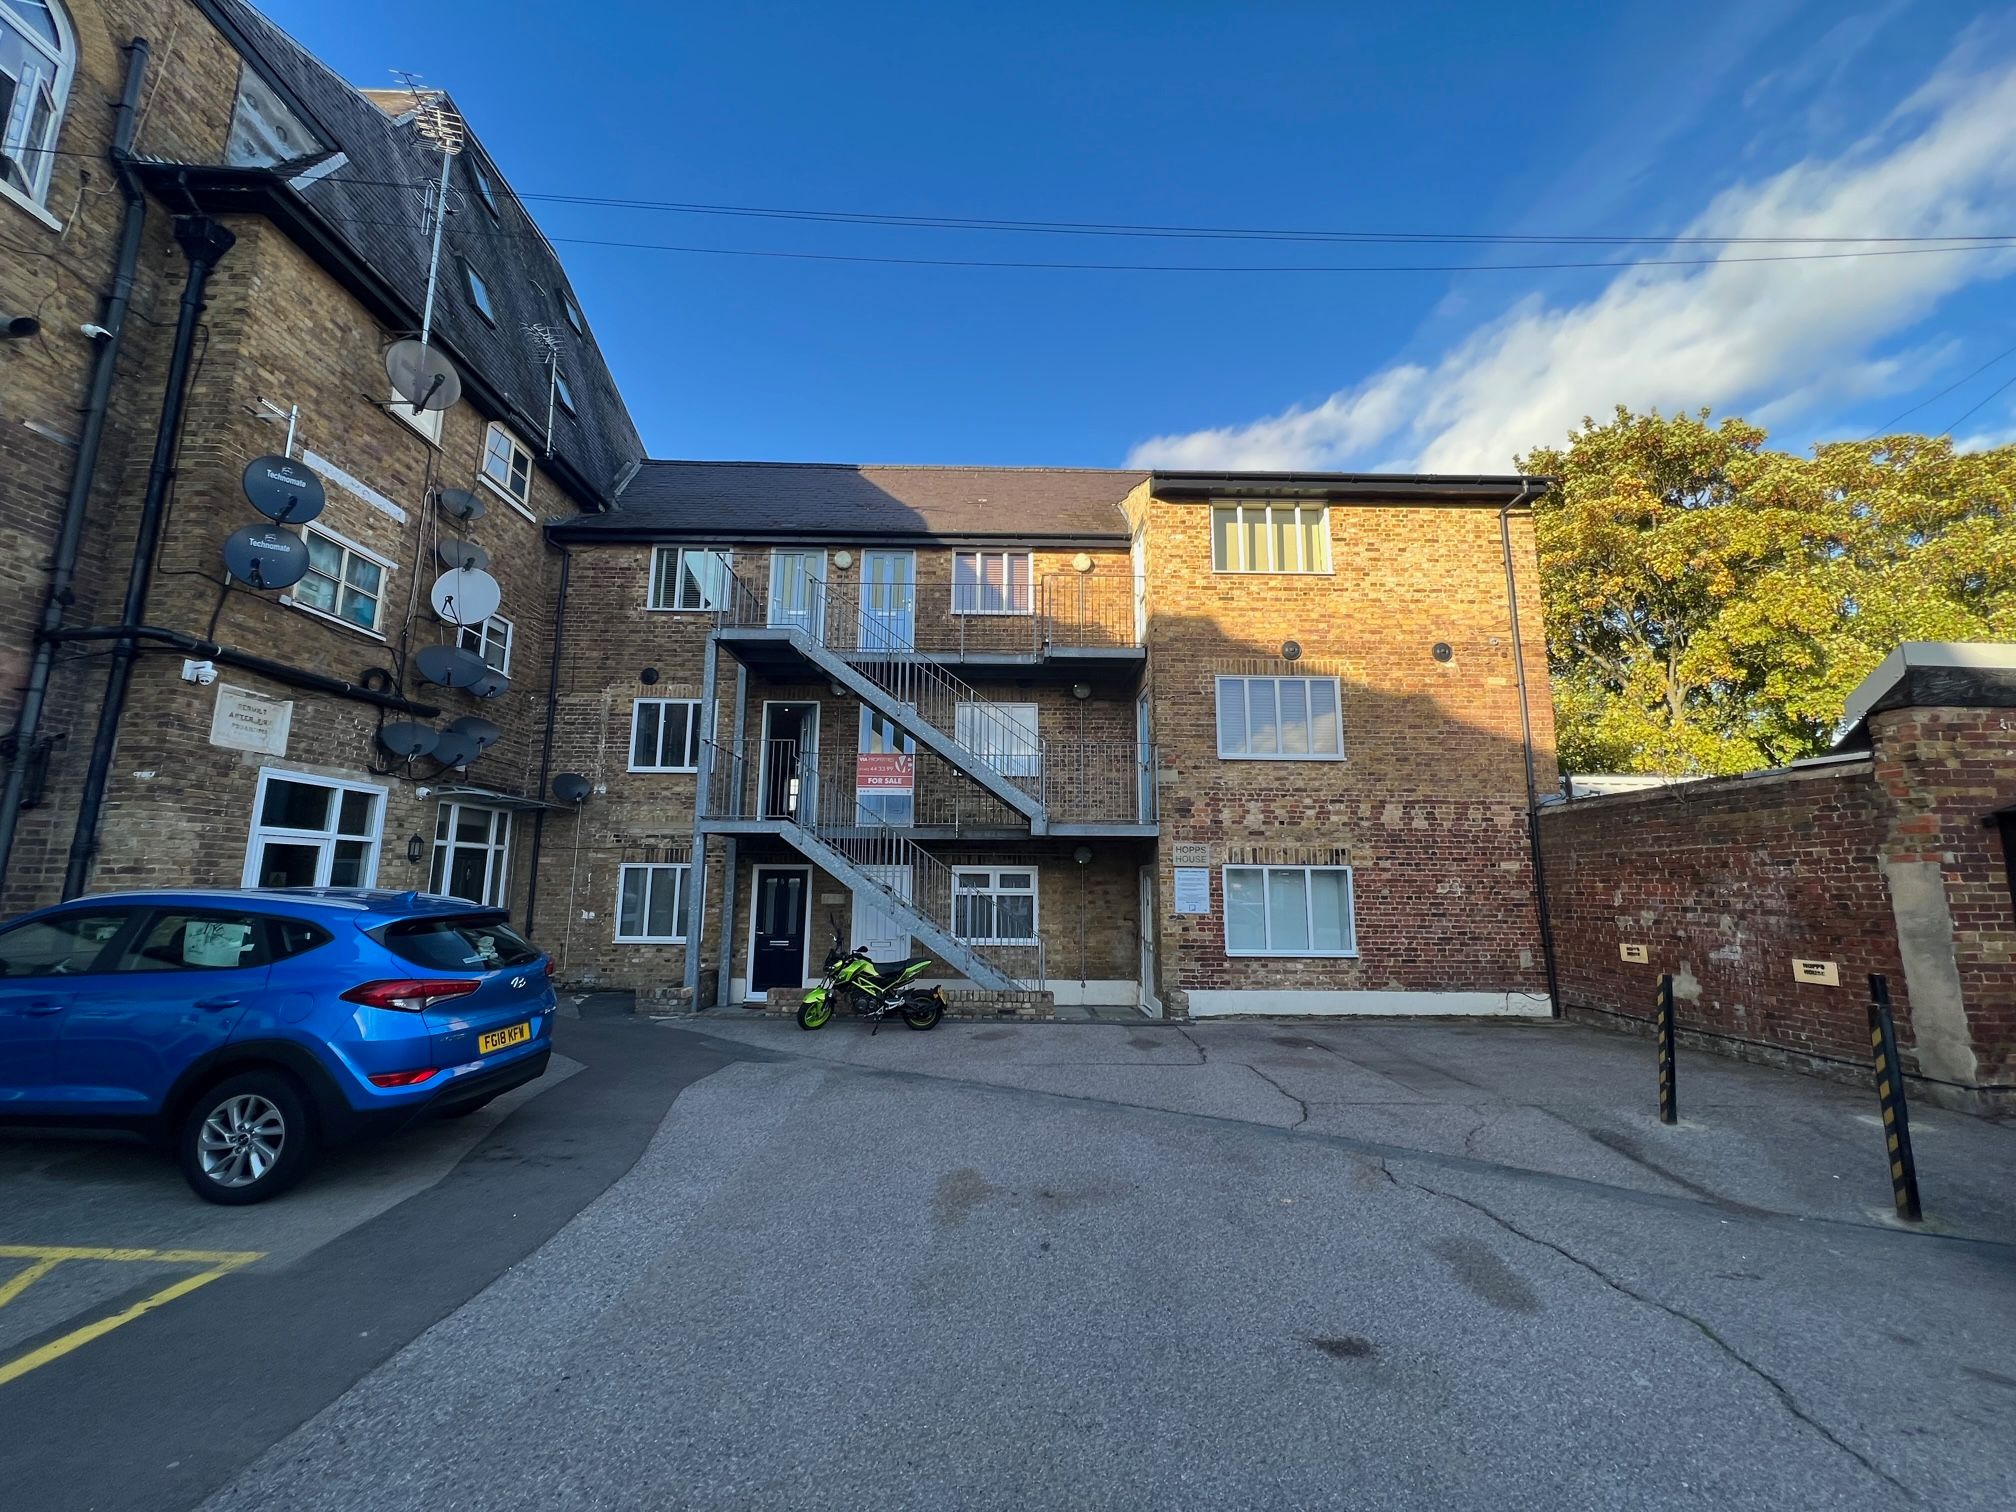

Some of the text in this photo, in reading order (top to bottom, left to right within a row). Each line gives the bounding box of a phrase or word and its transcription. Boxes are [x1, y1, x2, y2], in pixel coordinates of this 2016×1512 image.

[266, 469, 307, 488] Technomate
[249, 537, 291, 553] Technomate
[1175, 846, 1207, 854] HOPPS
[1175, 855, 1207, 864] HOUSE
[484, 1030, 507, 1050] FG18
[507, 1024, 525, 1043] KFW
